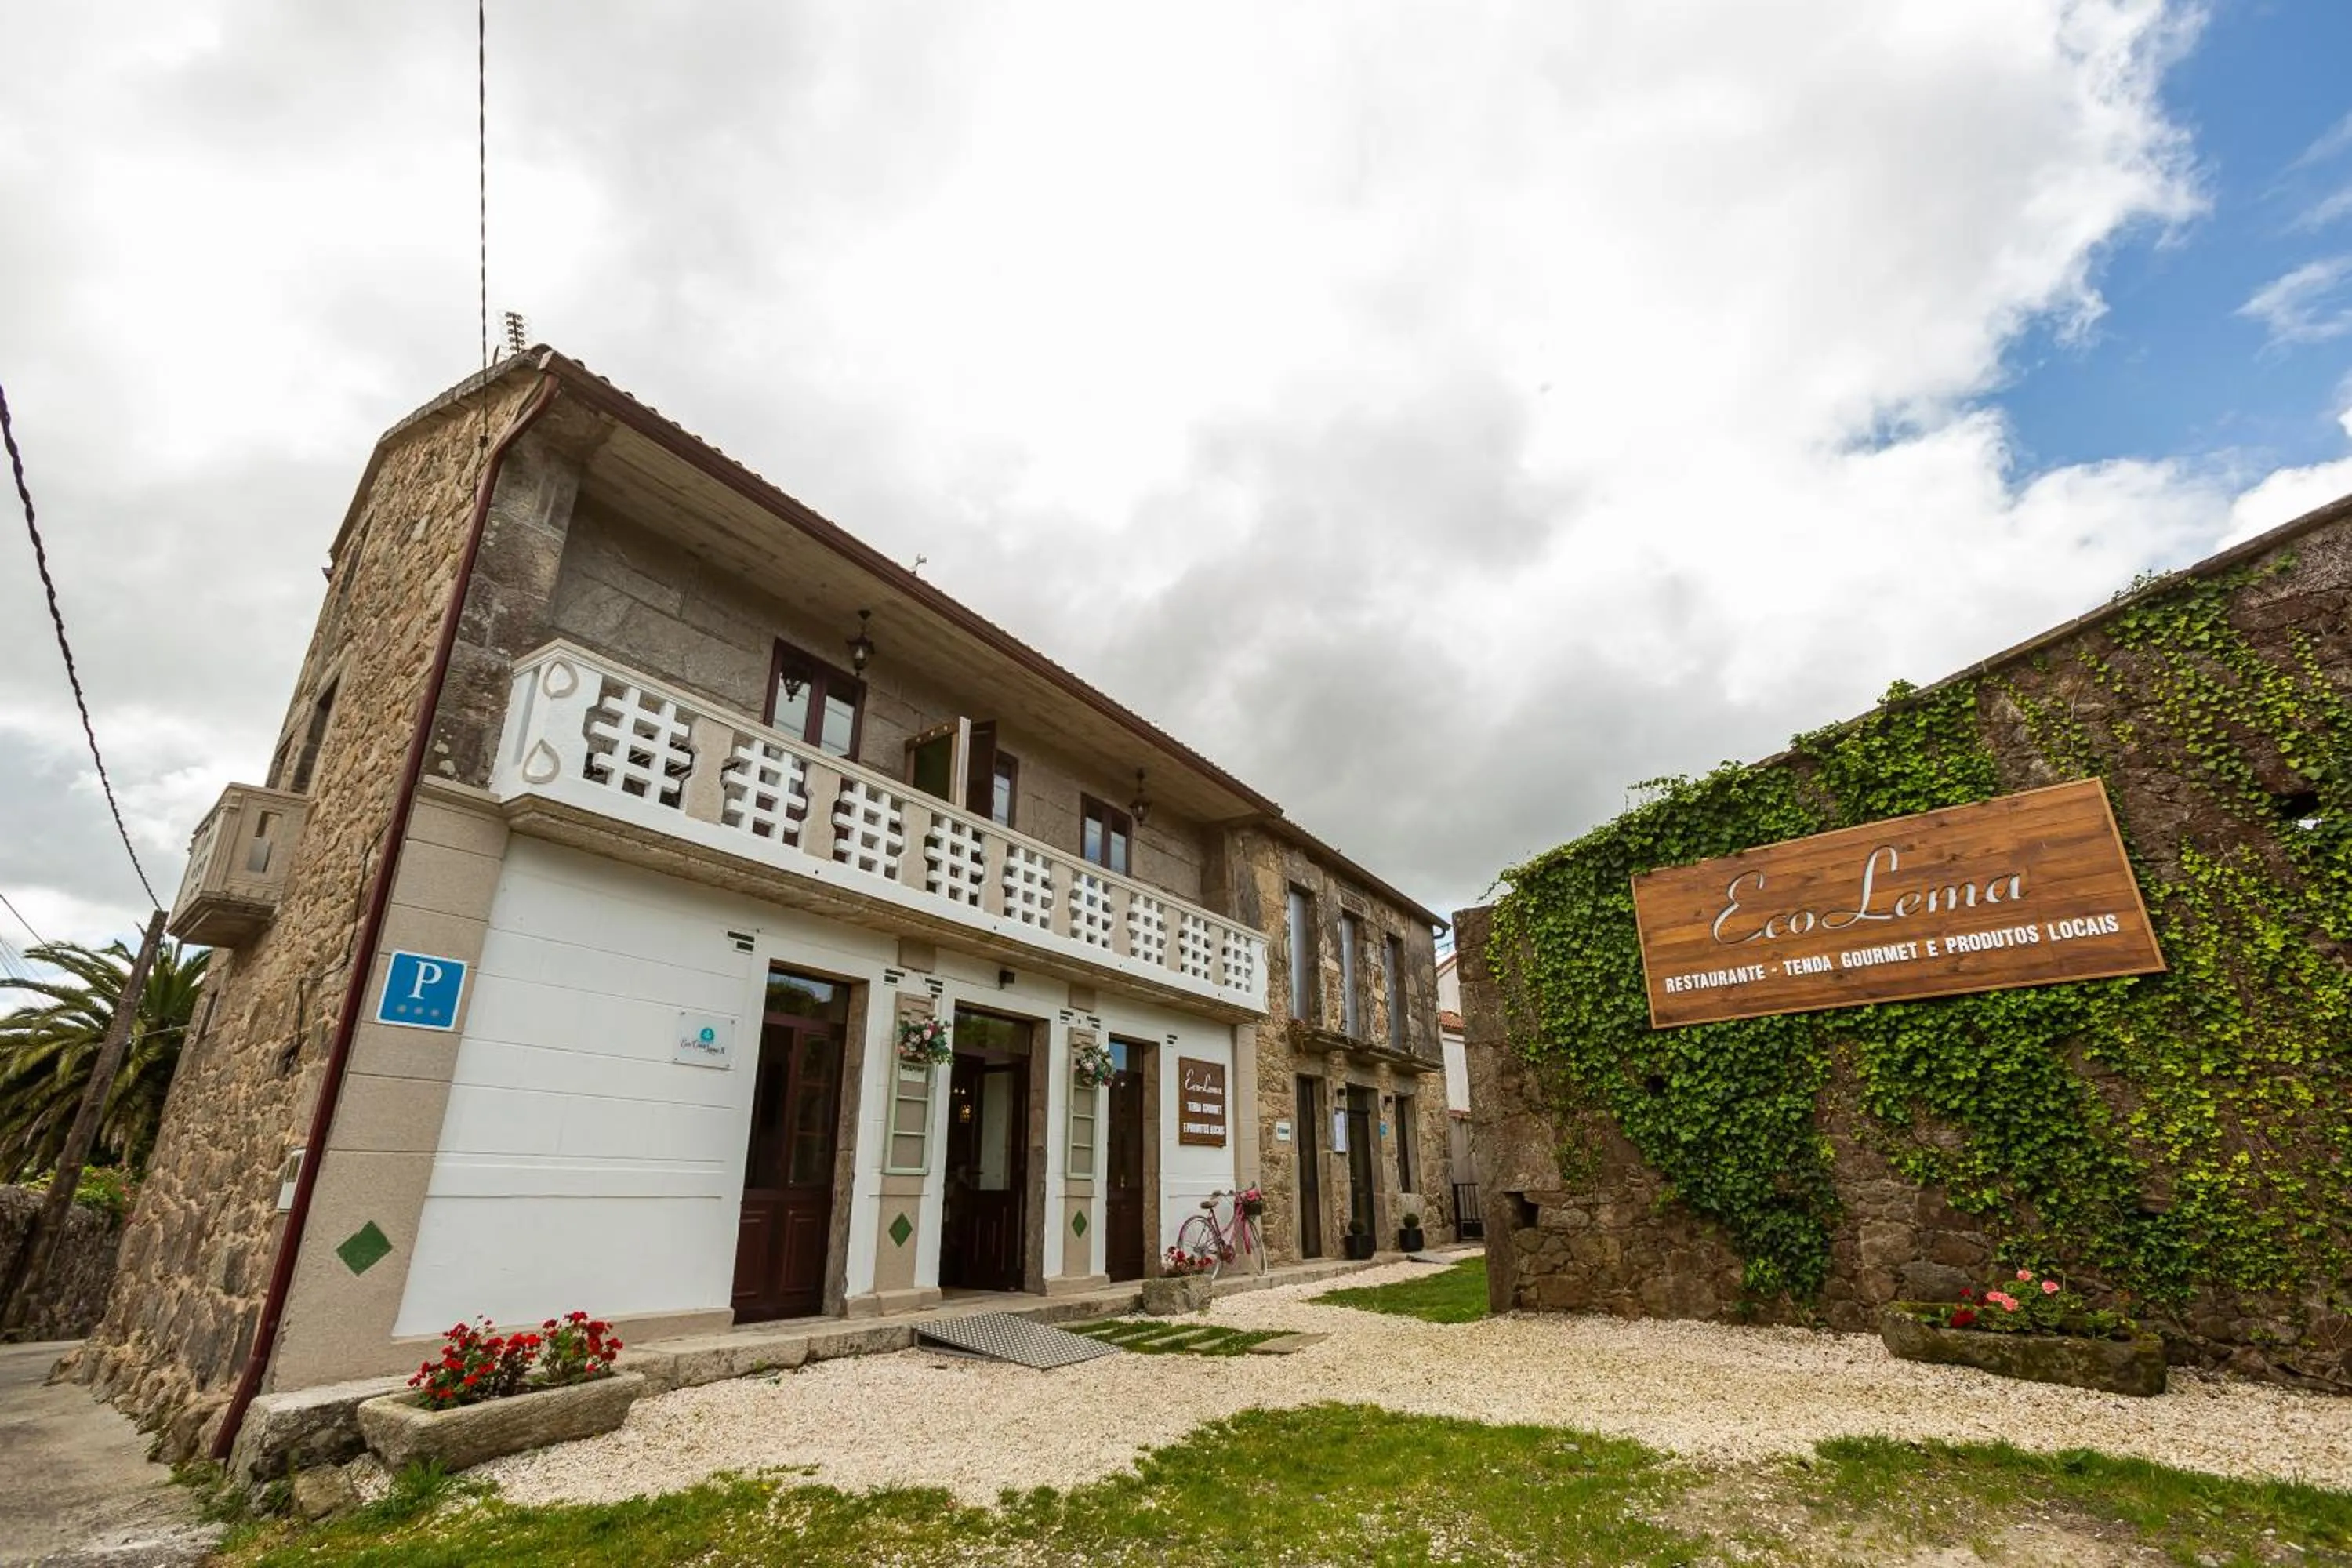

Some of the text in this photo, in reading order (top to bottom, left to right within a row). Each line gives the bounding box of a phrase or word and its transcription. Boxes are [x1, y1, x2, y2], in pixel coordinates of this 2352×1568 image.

[1712, 844, 2031, 944] Eco Lema
[407, 960, 443, 1000] P
[1664, 964, 1766, 993] RESTAURANTE
[1782, 955, 1833, 977] TENDA
[1840, 941, 1918, 969] GOURMET
[1926, 939, 1940, 957] E
[1944, 924, 2040, 954] PRODUTOS
[2047, 913, 2120, 942] LOCAIS
